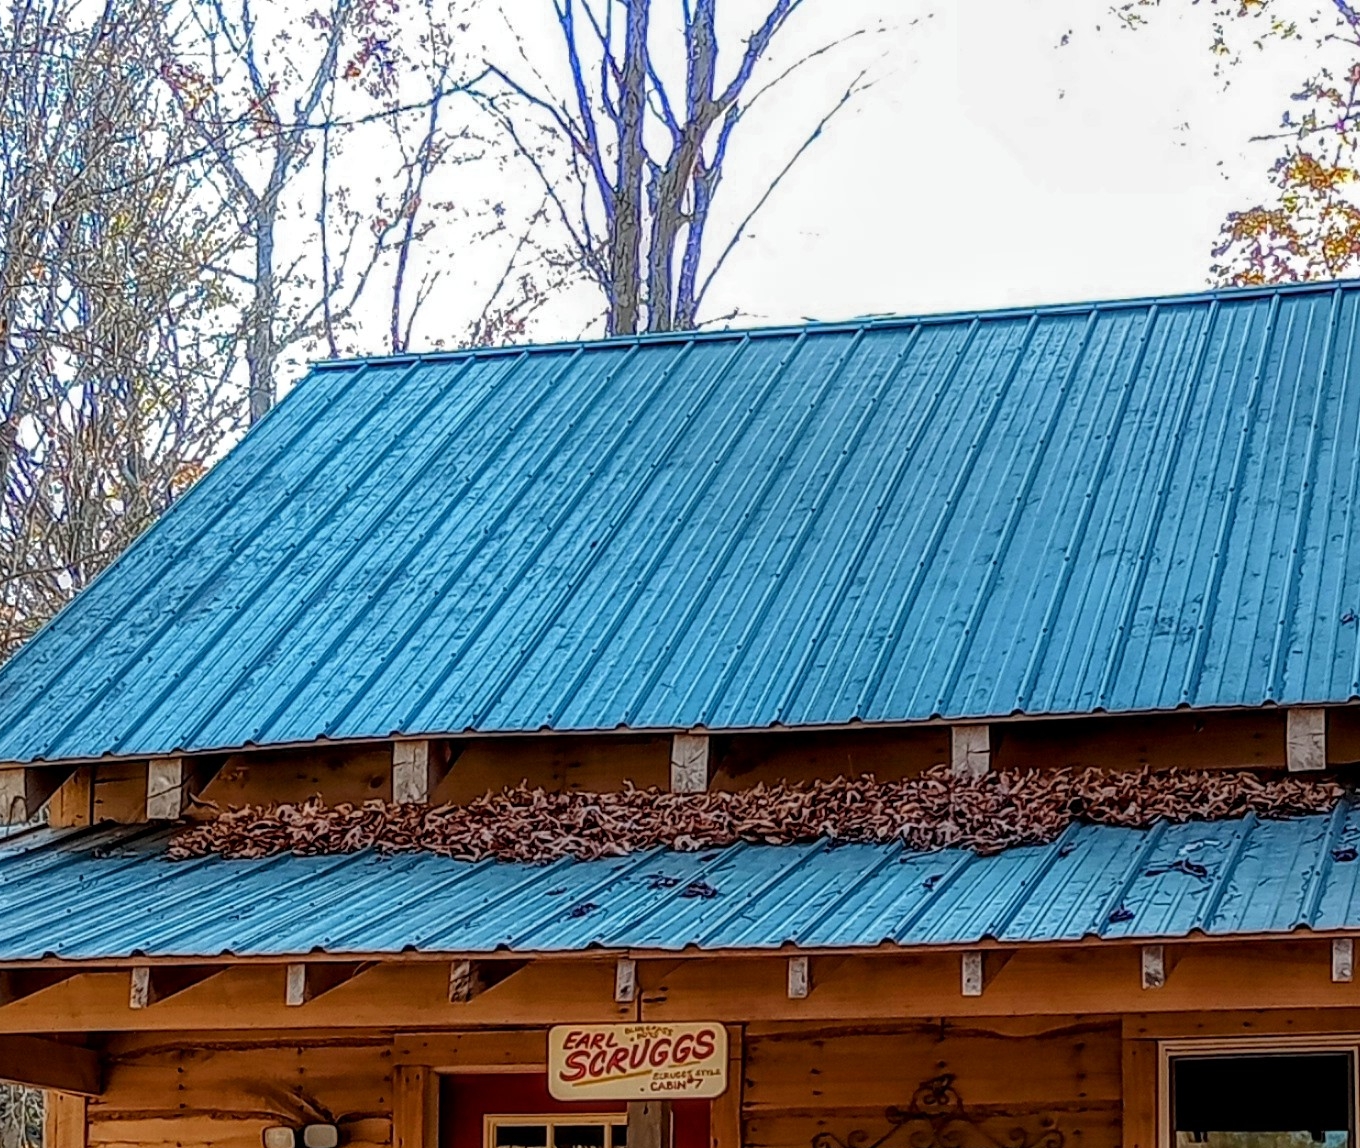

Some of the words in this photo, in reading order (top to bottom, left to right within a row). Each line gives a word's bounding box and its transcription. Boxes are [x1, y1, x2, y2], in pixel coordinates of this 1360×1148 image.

[562, 1031, 619, 1050] EARL
[559, 1028, 716, 1082] SCRUGGS
[650, 1080, 687, 1091] CABIN
